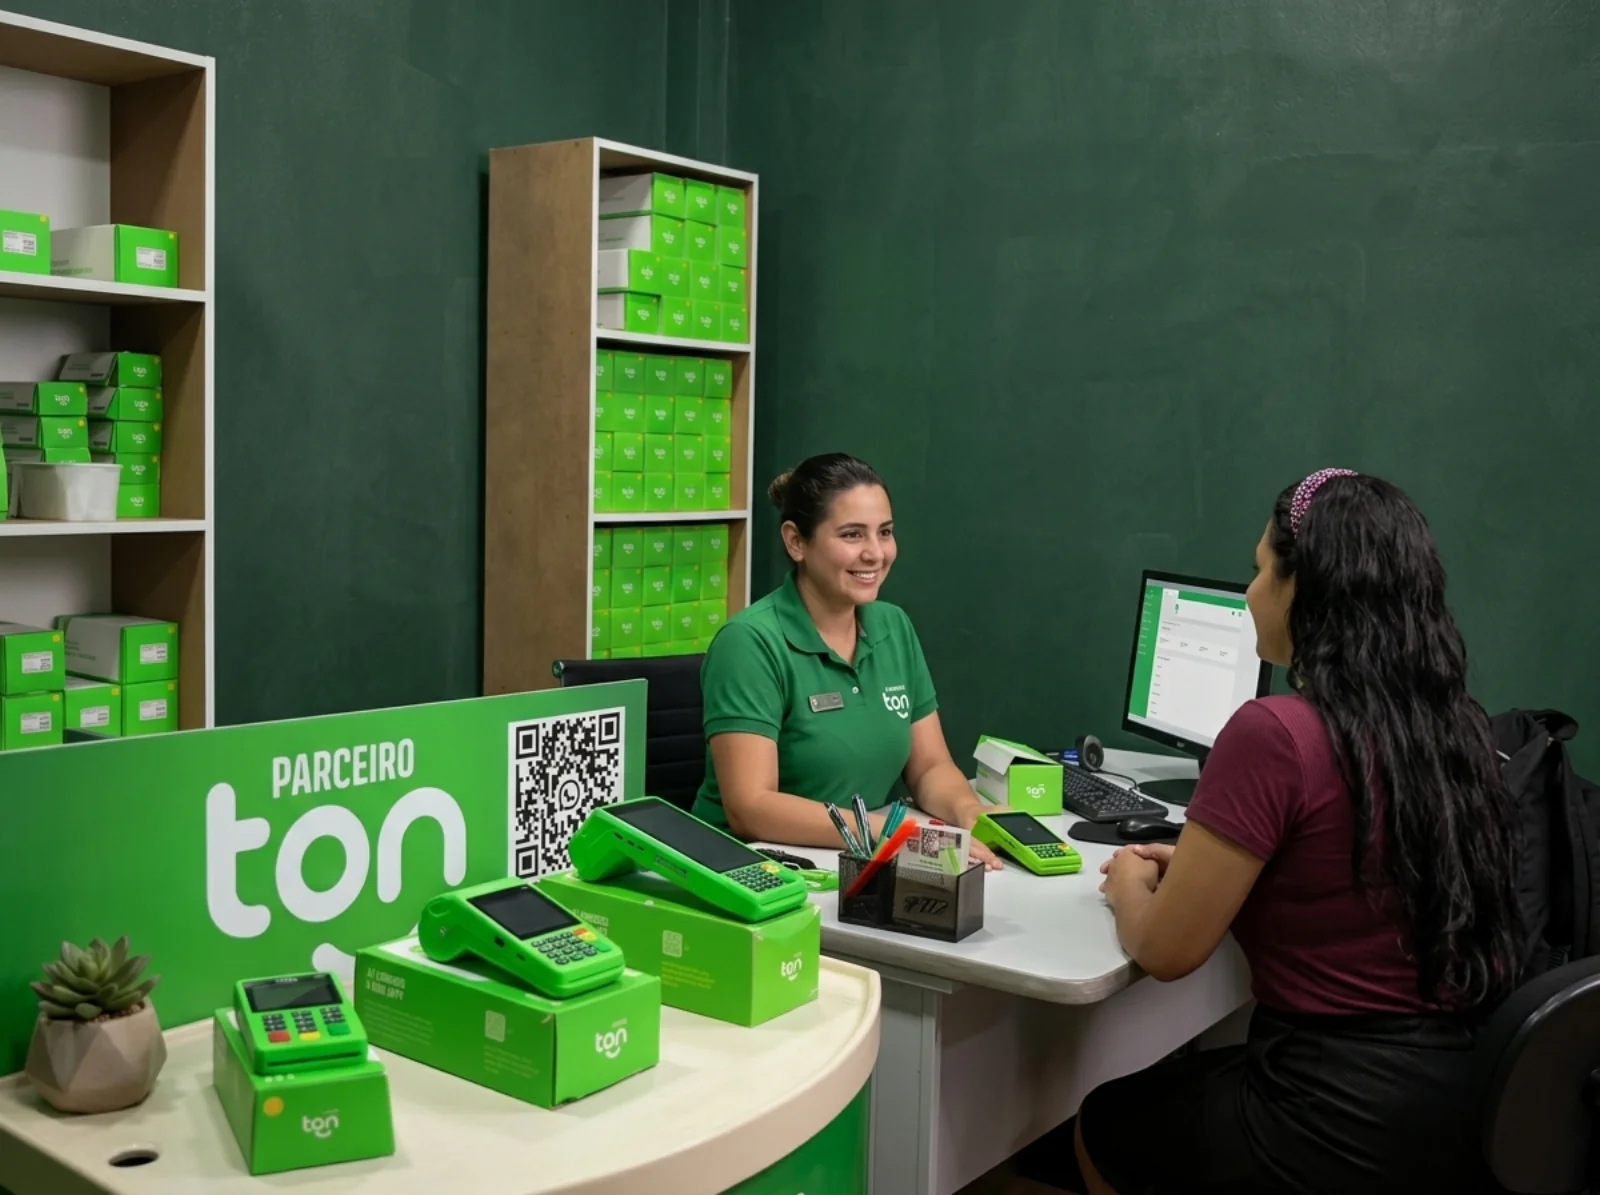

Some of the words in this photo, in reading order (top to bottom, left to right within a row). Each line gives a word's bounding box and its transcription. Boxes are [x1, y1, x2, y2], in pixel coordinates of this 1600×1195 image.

[882, 692, 909, 711] ton
[272, 738, 415, 799] PARCEIRO
[206, 782, 467, 938] ton
[781, 958, 802, 977] ton
[595, 1028, 628, 1053] ton
[302, 1115, 340, 1133] ton
